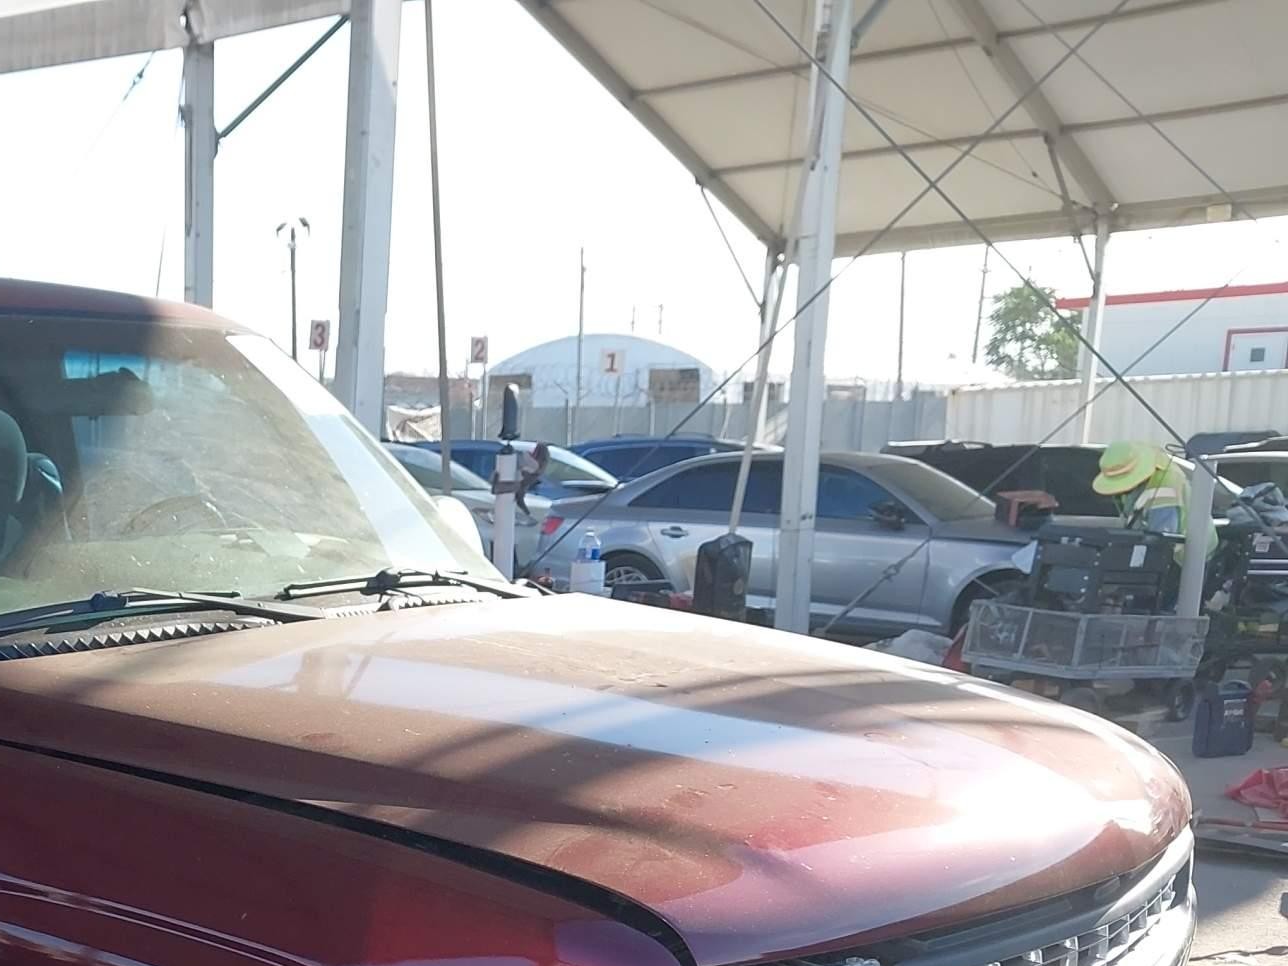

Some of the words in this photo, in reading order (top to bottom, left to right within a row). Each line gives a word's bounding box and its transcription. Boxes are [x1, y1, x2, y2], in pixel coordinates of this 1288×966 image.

[314, 323, 325, 347] 3
[474, 339, 484, 361] 2
[605, 353, 617, 372] 1
